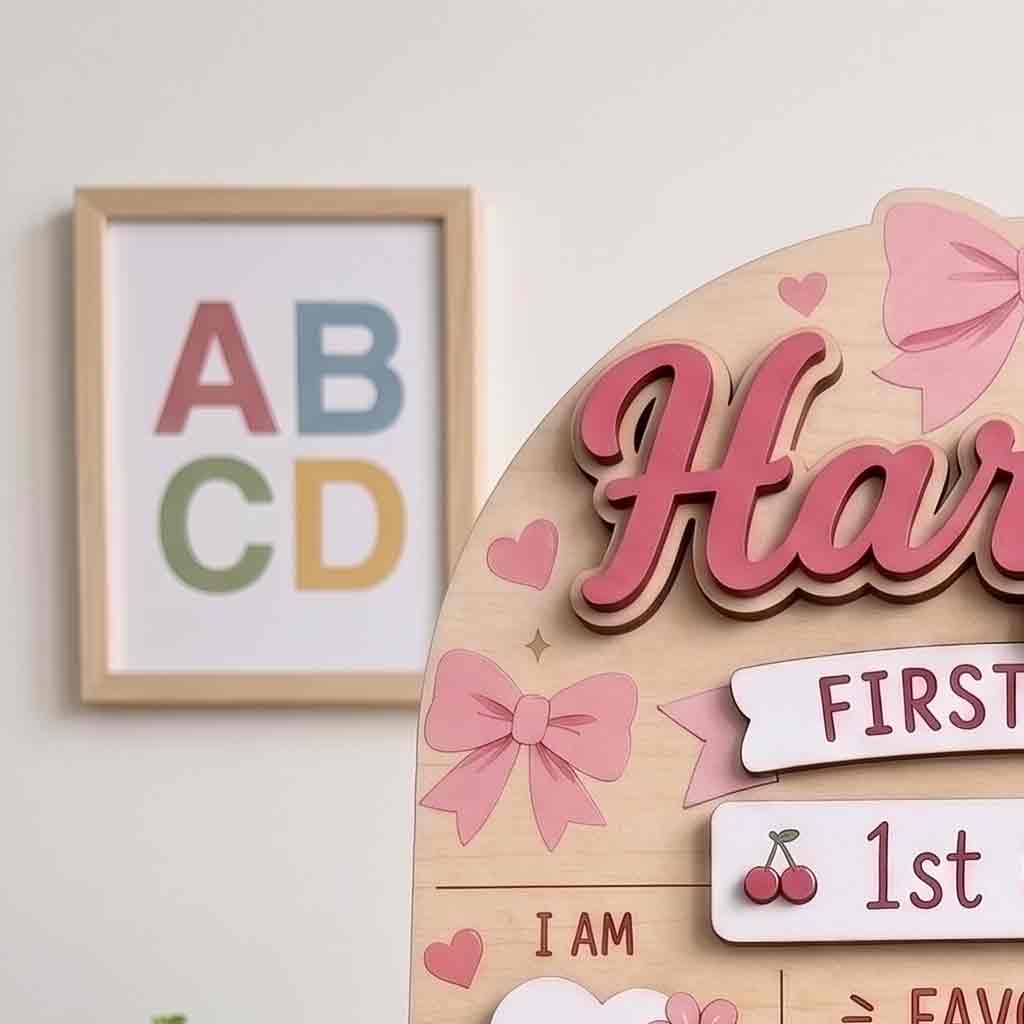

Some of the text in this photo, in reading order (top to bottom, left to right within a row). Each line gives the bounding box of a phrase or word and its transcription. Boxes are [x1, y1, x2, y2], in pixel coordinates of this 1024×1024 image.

[865, 820, 984, 911] 1st
[535, 911, 635, 958] I AM
